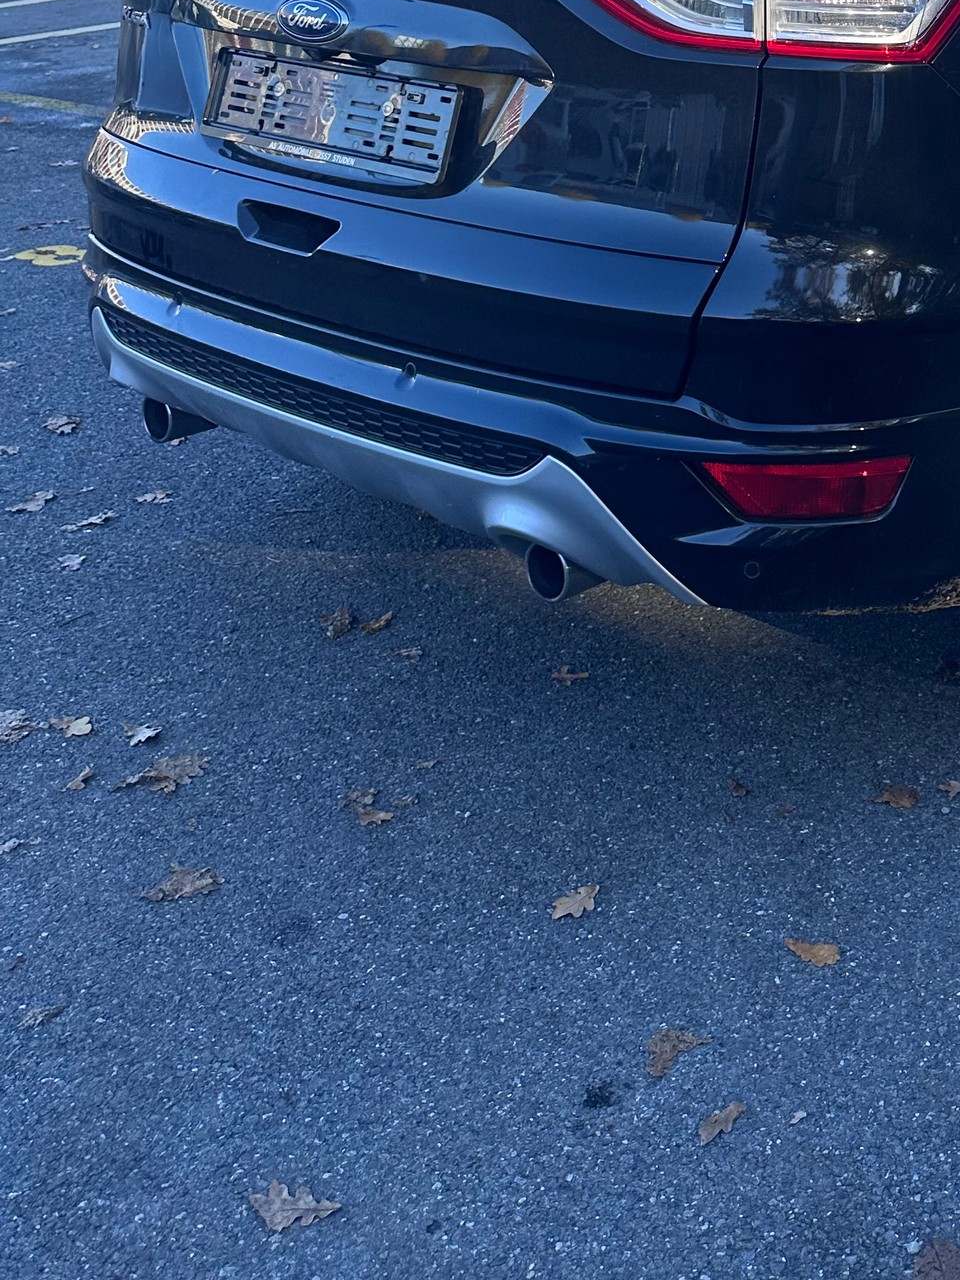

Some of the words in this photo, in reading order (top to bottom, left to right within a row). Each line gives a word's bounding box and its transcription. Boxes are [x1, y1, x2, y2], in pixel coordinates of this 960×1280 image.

[287, 3, 327, 30] Ford
[268, 141, 278, 150] AS
[278, 143, 313, 157] AUTOMOBILE
[317, 151, 331, 161] 2557
[332, 154, 356, 166] STUDEN
